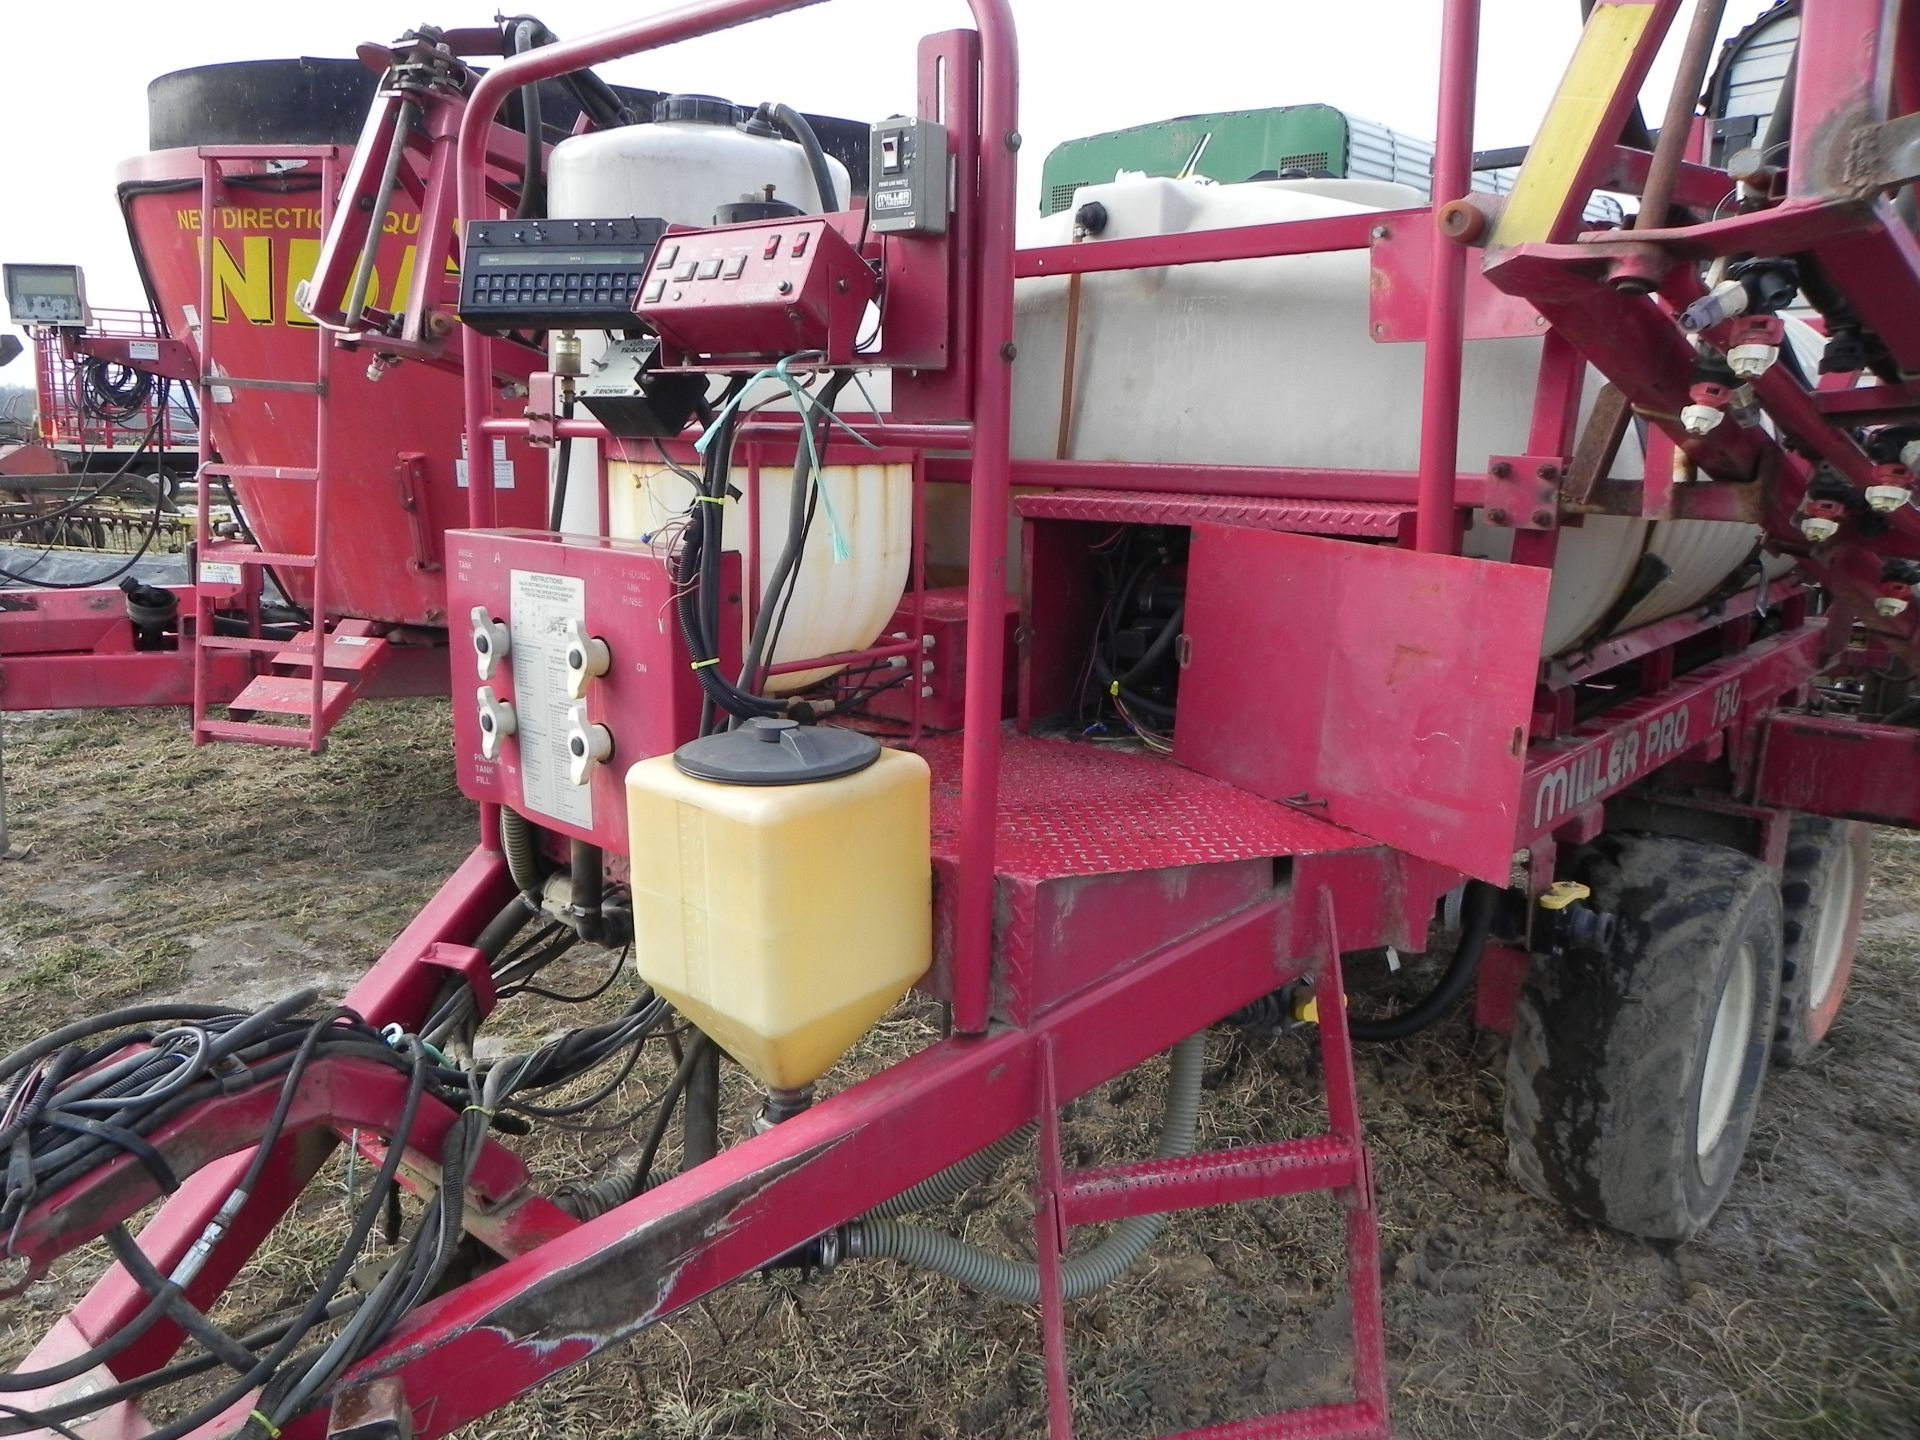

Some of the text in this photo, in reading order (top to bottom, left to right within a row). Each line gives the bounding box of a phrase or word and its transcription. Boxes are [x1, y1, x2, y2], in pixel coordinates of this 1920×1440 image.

[877, 191, 910, 204] MILLER
[222, 208, 322, 229] DIRECTI
[636, 662, 647, 673] ON
[475, 764, 494, 775] TANK
[1534, 730, 1641, 830] MILLER
[1643, 705, 1690, 768] PRO
[476, 776, 490, 785] FILL
